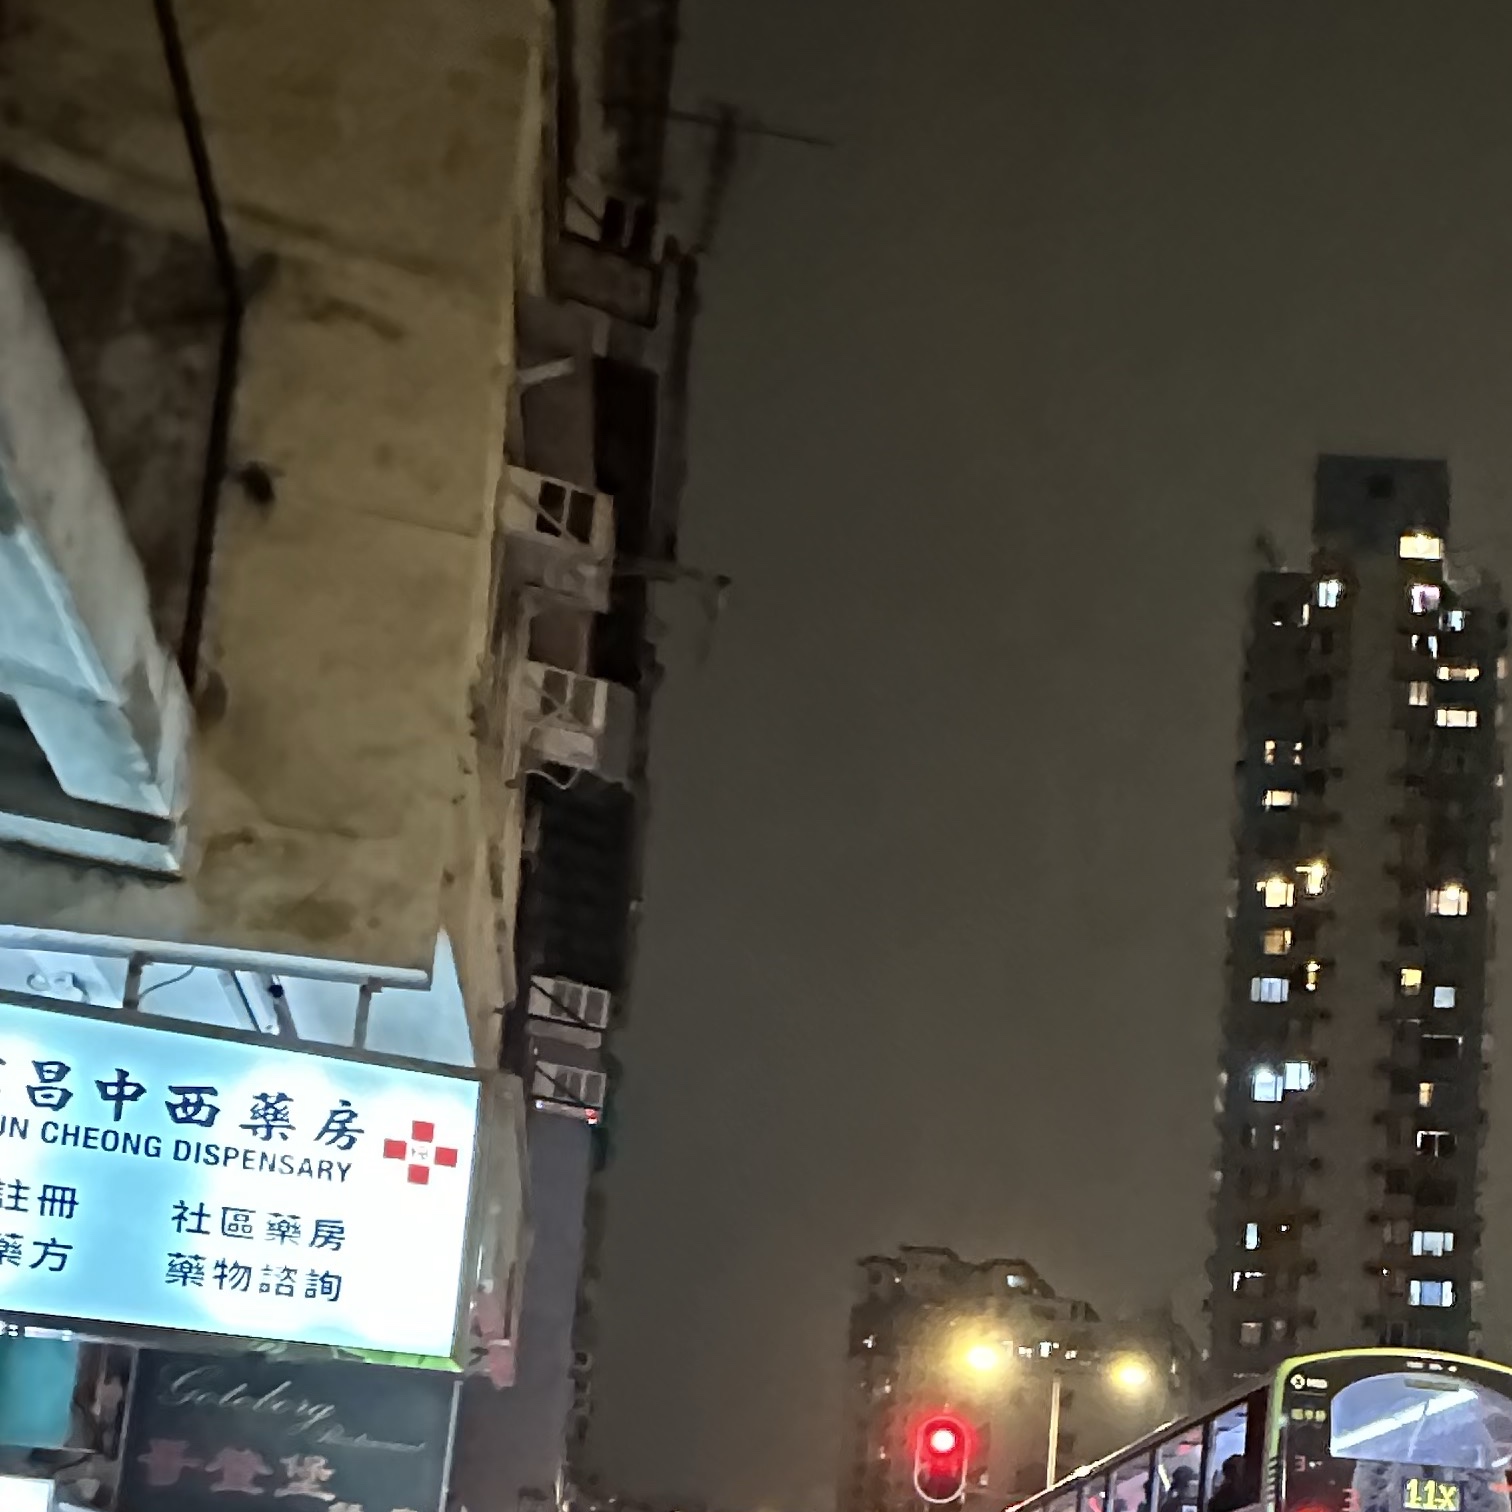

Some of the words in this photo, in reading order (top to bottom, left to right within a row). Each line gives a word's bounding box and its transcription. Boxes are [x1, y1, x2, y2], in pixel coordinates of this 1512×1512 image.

[0, 1058, 365, 1151] 昌中西藥房
[41, 1121, 162, 1158] CHEONG
[172, 1139, 352, 1183] DISPENSARY
[171, 1200, 346, 1251] 社區藥房
[165, 1252, 342, 1302] 藥物諮詢
